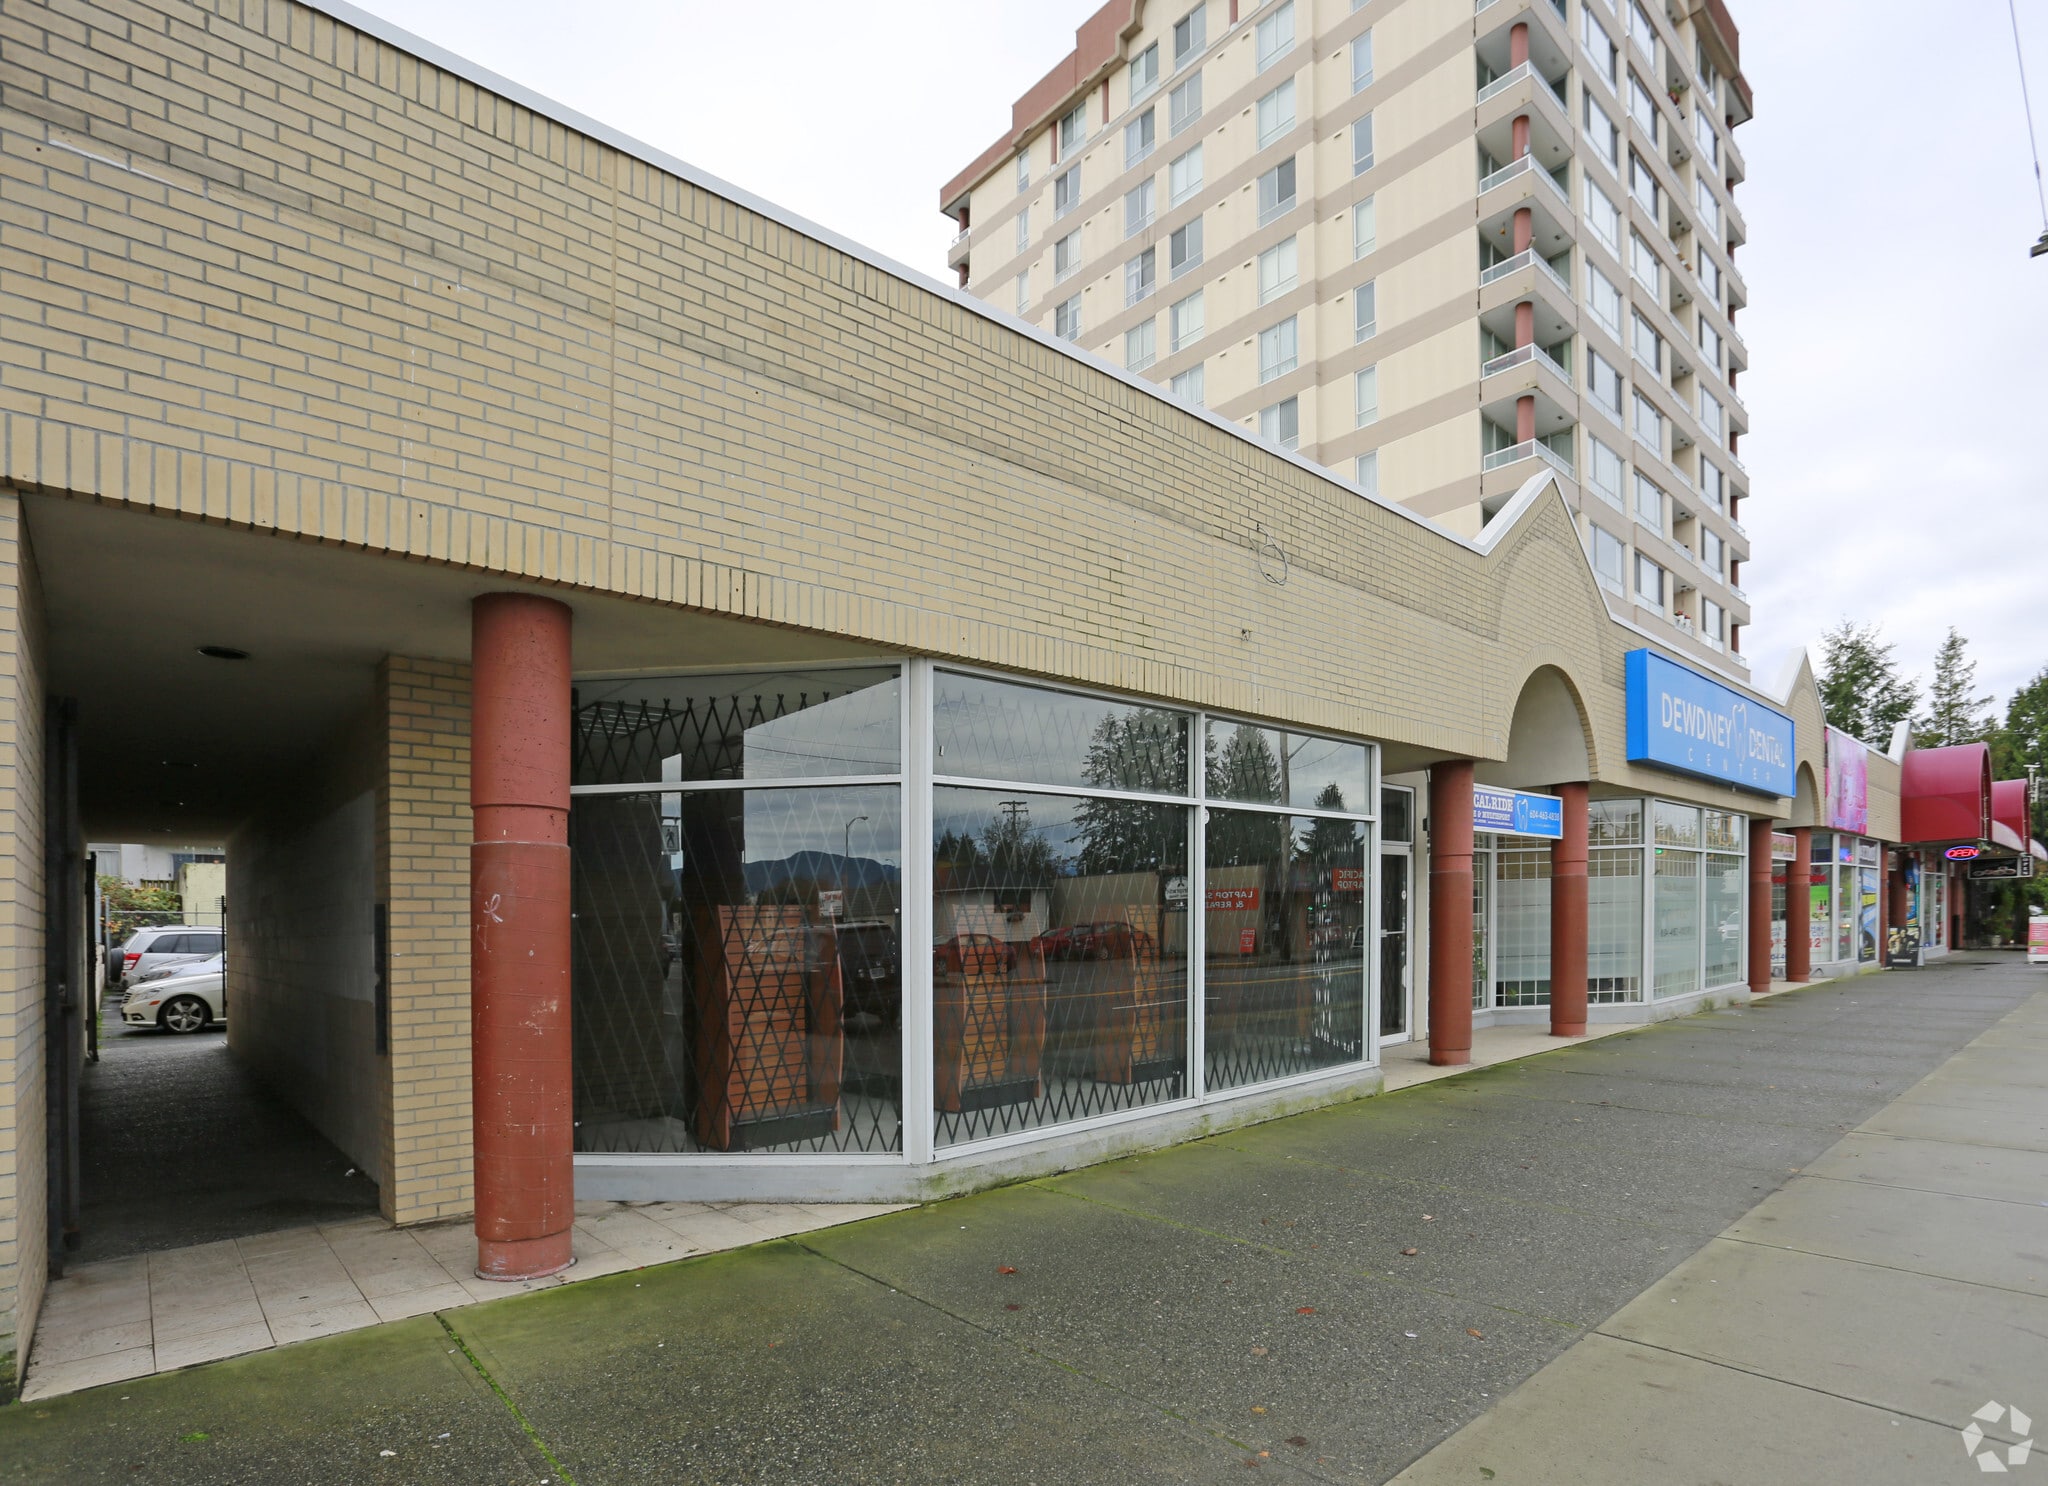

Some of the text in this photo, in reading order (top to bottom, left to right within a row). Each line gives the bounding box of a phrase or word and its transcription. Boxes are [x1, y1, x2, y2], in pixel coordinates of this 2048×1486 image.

[1661, 691, 1786, 768] DEWDNEY DENTAL
[1688, 747, 1771, 783] CENTER
[1947, 848, 1979, 858] OPEN
